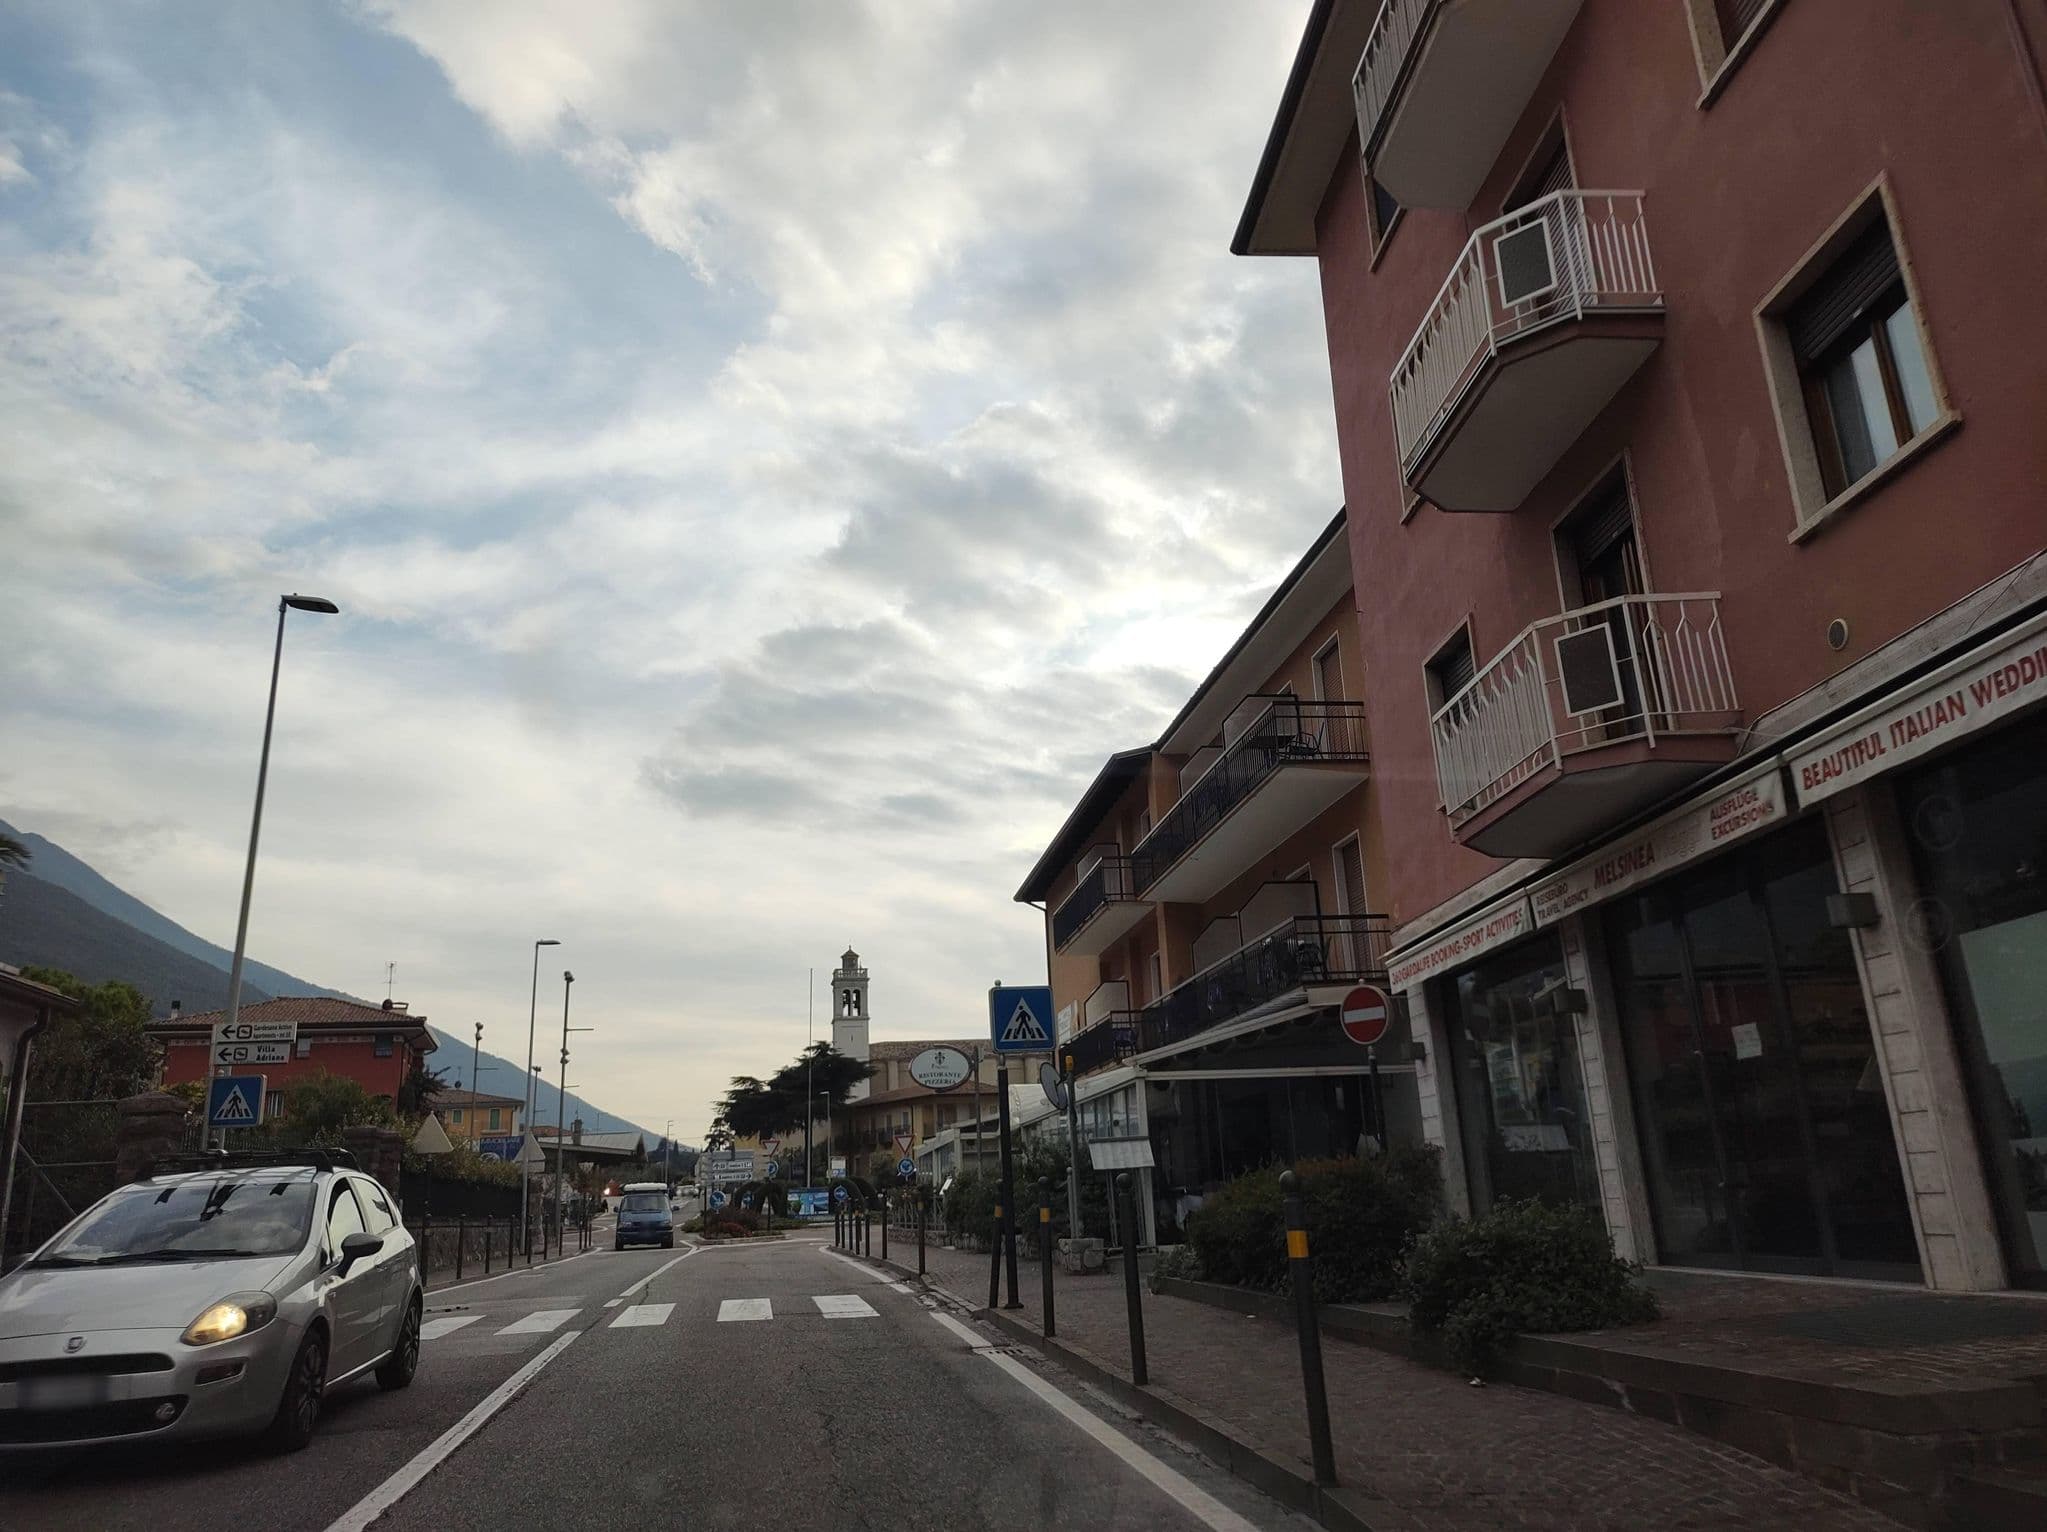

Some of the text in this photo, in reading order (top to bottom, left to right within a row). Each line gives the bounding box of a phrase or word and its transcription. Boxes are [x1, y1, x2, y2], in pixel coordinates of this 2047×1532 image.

[1802, 732, 1888, 790] BEAUTIFUL
[1888, 691, 1966, 749] ITALIAN
[1711, 789, 1759, 821] AUSFLÜGE
[1594, 842, 1656, 890] MELSINEA
[1538, 888, 1588, 920] TRAVEL AGENCY
[257, 1045, 275, 1053] Villa
